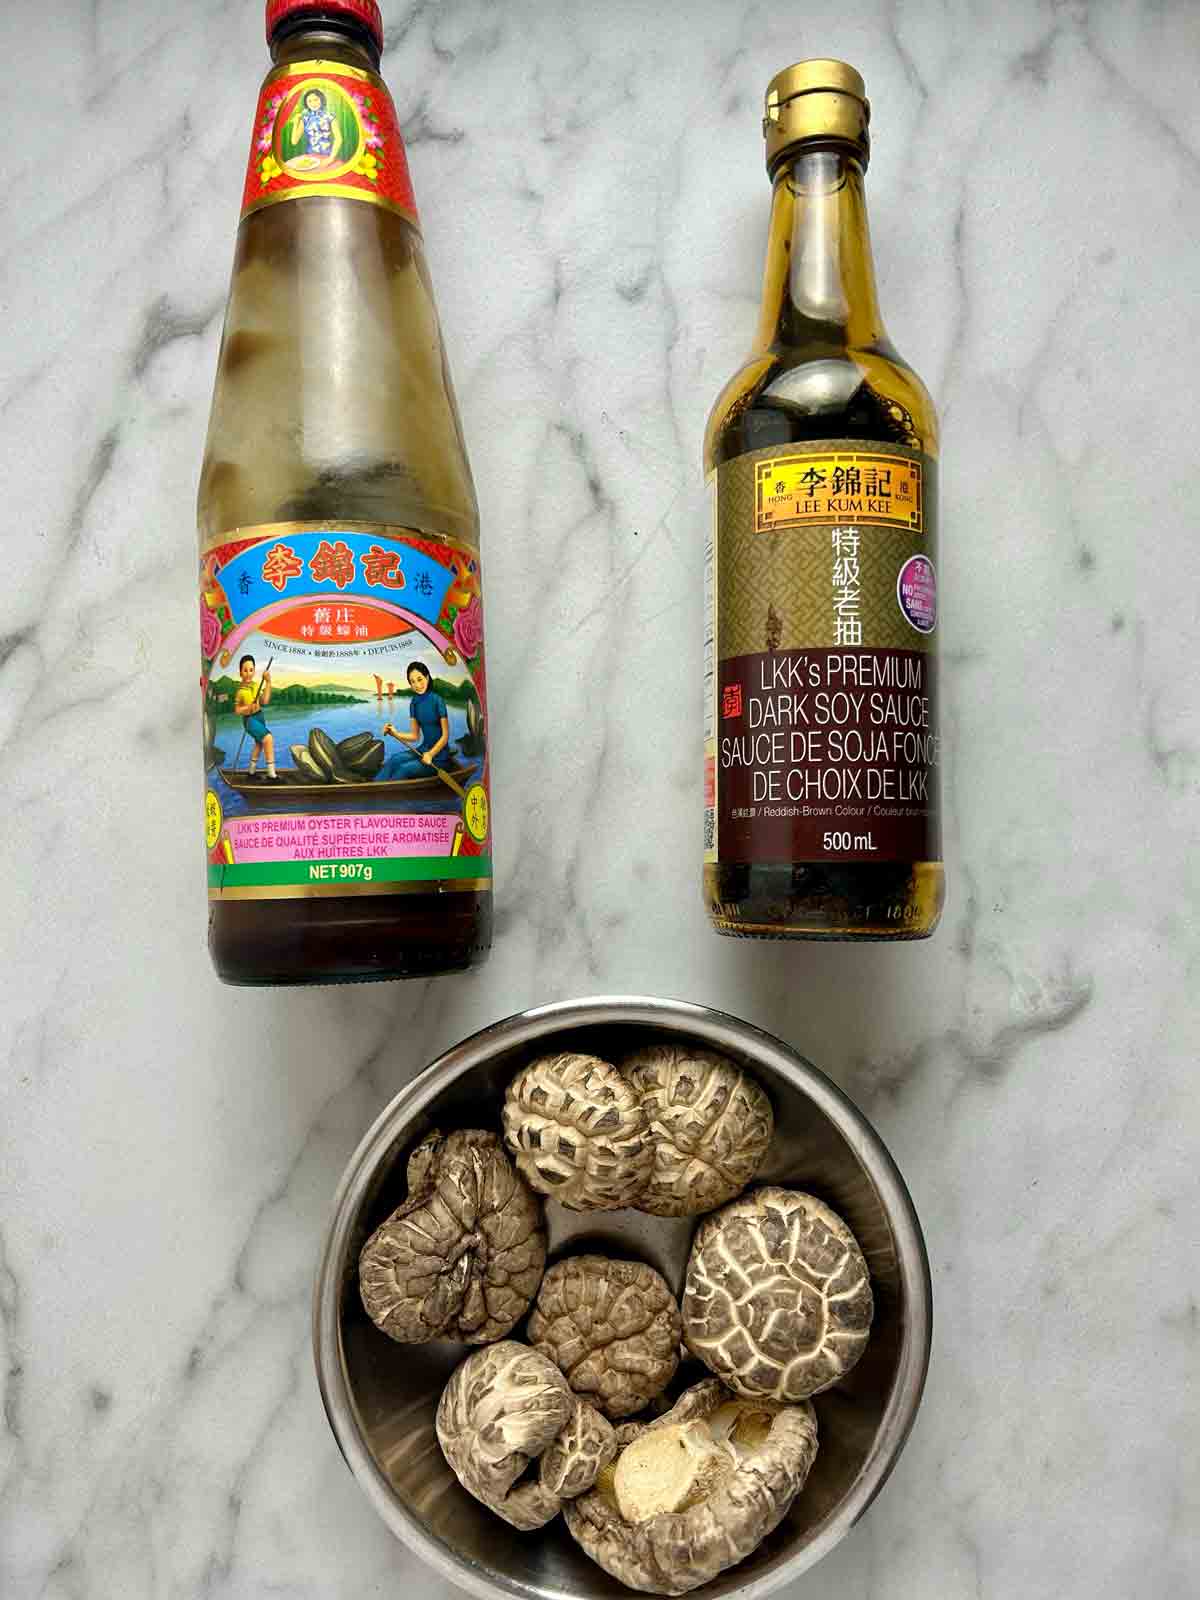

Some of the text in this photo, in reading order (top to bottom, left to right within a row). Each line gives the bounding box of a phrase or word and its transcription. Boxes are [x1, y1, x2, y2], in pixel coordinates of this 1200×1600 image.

[799, 466, 892, 498] 李錦記
[796, 498, 892, 514] LEE KUM KEE
[262, 541, 405, 590] 李錦記
[831, 527, 862, 646] 特級老抽
[761, 655, 921, 691] LKK's PREMIUM
[749, 695, 809, 728] DARK
[815, 693, 865, 726] SOY
[870, 694, 929, 728] SAUCE
[722, 733, 785, 768] SAUCE
[791, 731, 822, 763] DE
[828, 731, 889, 763] SOJA
[753, 769, 929, 801] DE CHOIX DE LKK
[763, 805, 834, 817] Reddish-Brown
[834, 806, 865, 817] Colour
[261, 819, 306, 833] PREMIUM
[308, 818, 353, 831] OYSTER
[355, 817, 415, 829] FLAVOURED
[418, 816, 448, 828] SAUCE
[261, 836, 274, 848] DE
[276, 832, 319, 847] QUALITÉ
[294, 847, 314, 859] AUX
[367, 845, 389, 857] LKK
[823, 831, 878, 851] 500 mL
[309, 863, 373, 881] NET 907g
